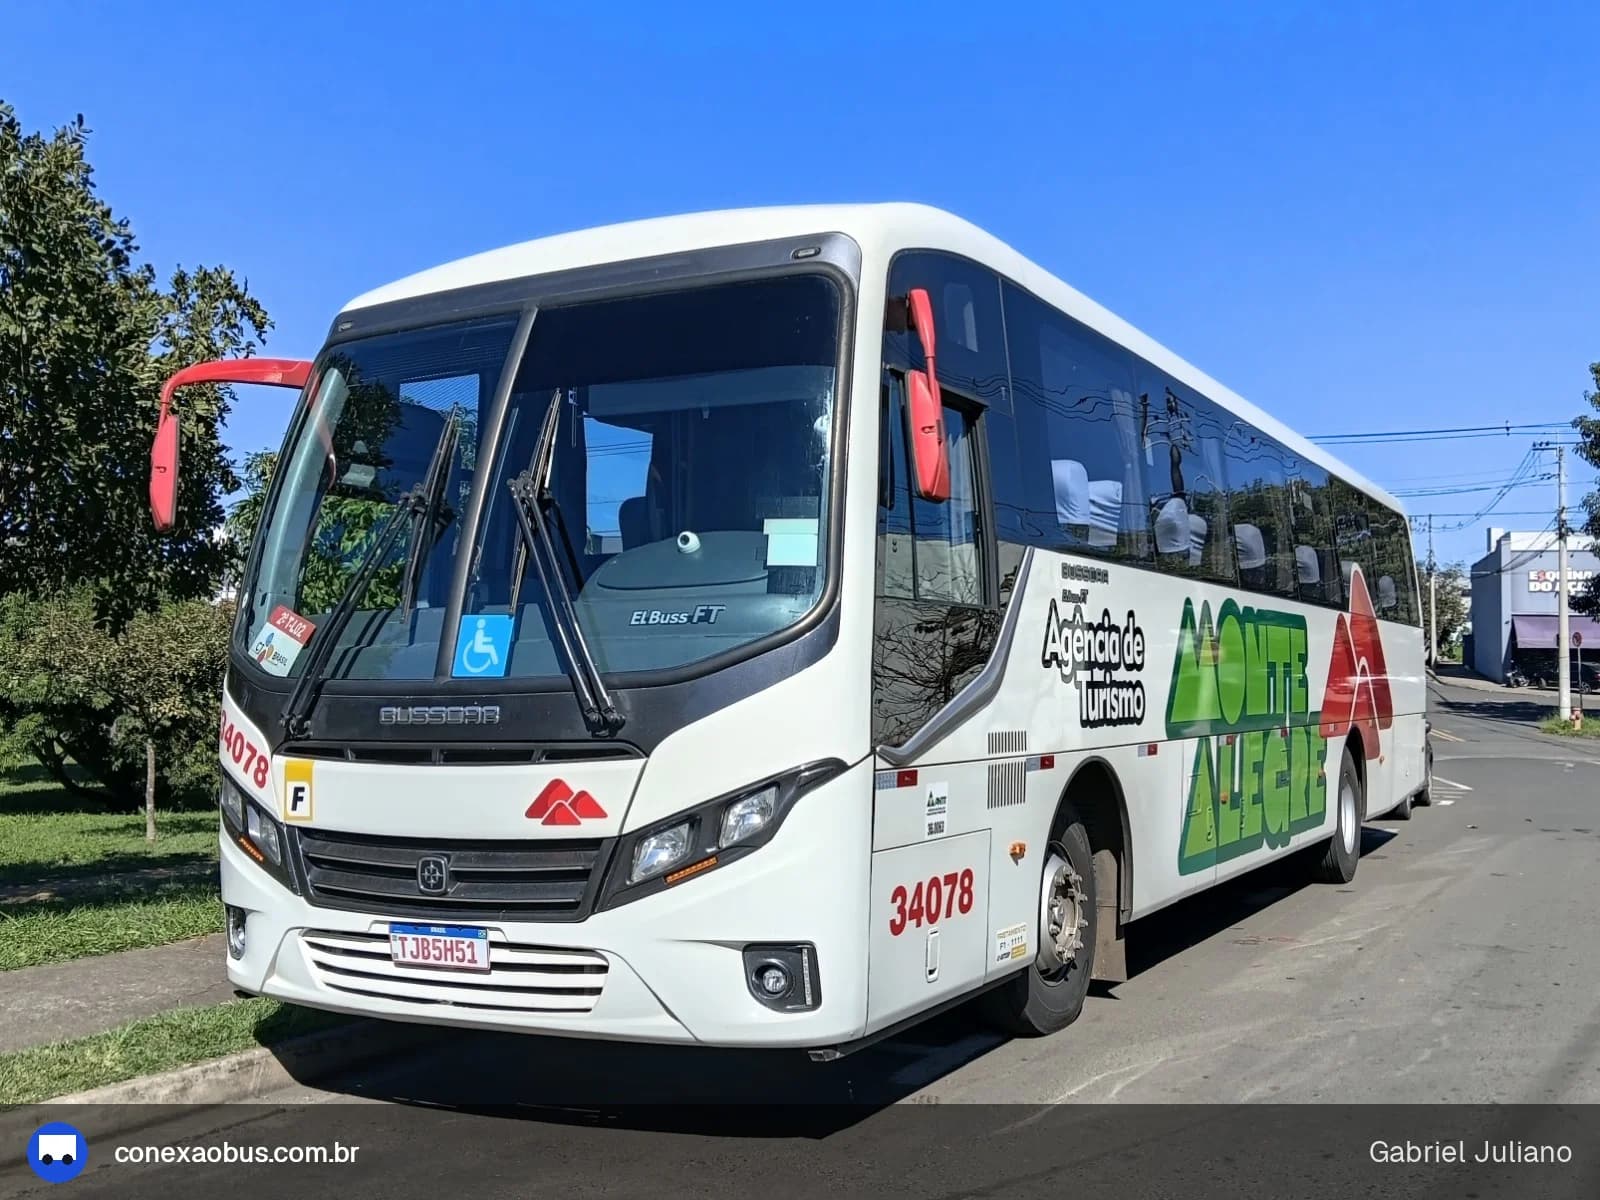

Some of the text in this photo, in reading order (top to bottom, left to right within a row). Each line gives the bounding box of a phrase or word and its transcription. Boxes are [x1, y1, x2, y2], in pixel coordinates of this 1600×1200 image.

[1529, 568, 1592, 582] ESQINA
[1529, 581, 1552, 592] DO
[690, 604, 727, 624] FT
[1043, 600, 1145, 682] Agência de
[1167, 600, 1308, 733] MONTE
[1076, 670, 1145, 726] Turismo
[380, 705, 500, 725] BUSSCAR
[291, 786, 305, 812] F
[1180, 724, 1327, 868] ALEGRE
[889, 868, 974, 937] 34078
[398, 936, 477, 964] TJB5H51
